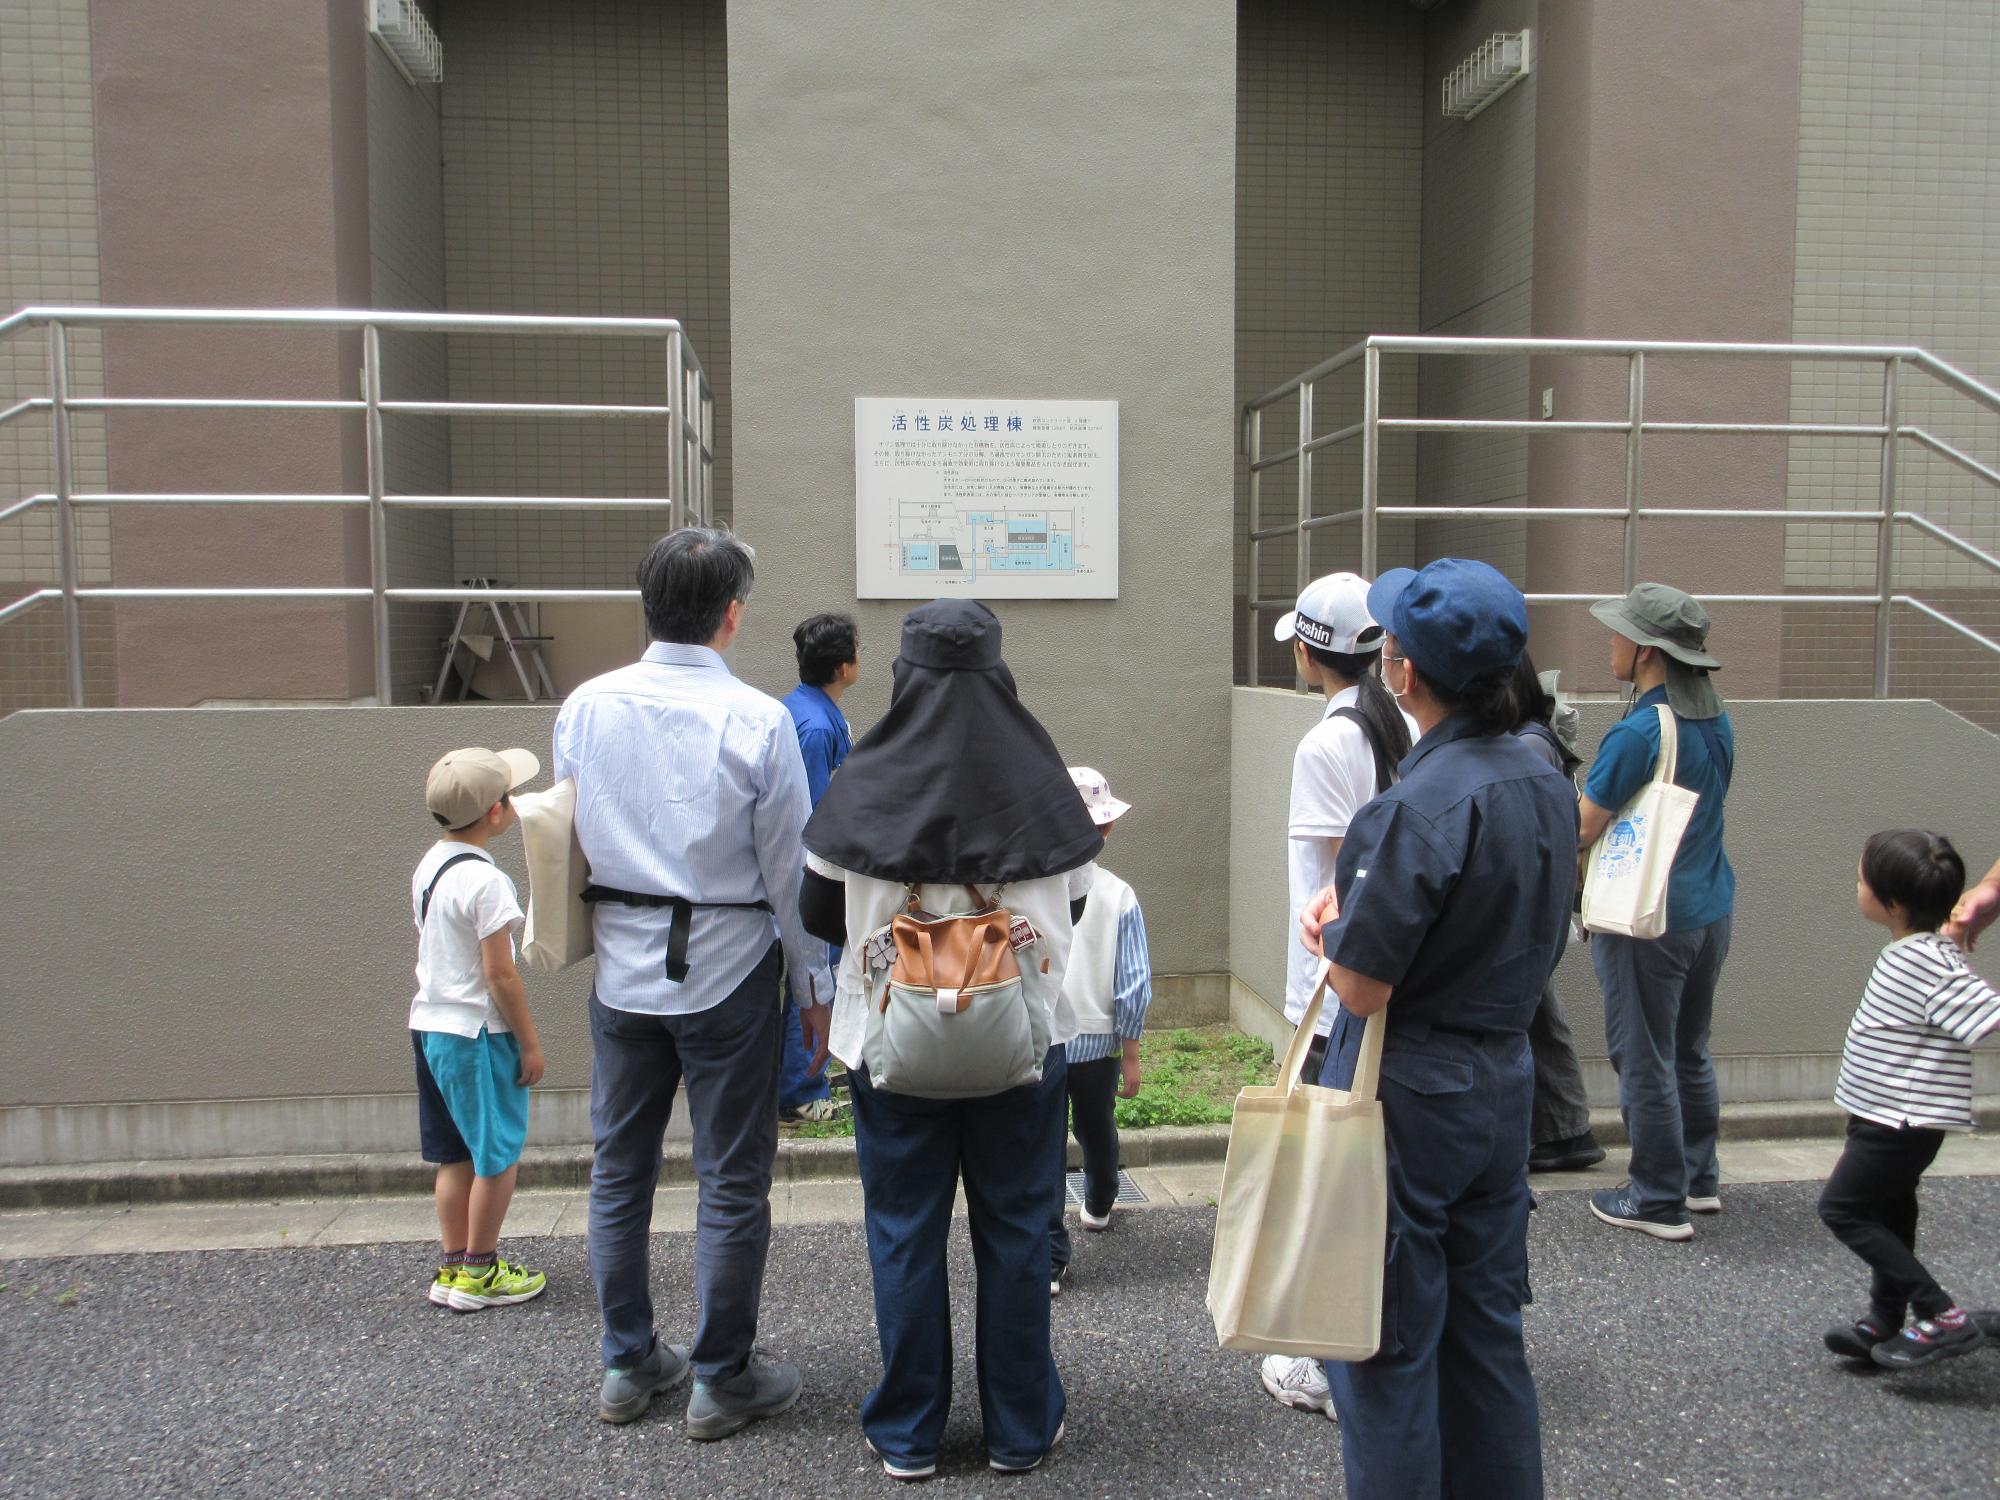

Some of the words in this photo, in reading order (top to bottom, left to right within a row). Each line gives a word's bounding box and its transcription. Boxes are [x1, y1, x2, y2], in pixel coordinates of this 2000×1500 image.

[891, 415, 1023, 432] 活性炭処理棟
[1296, 615, 1330, 644] Joshin
